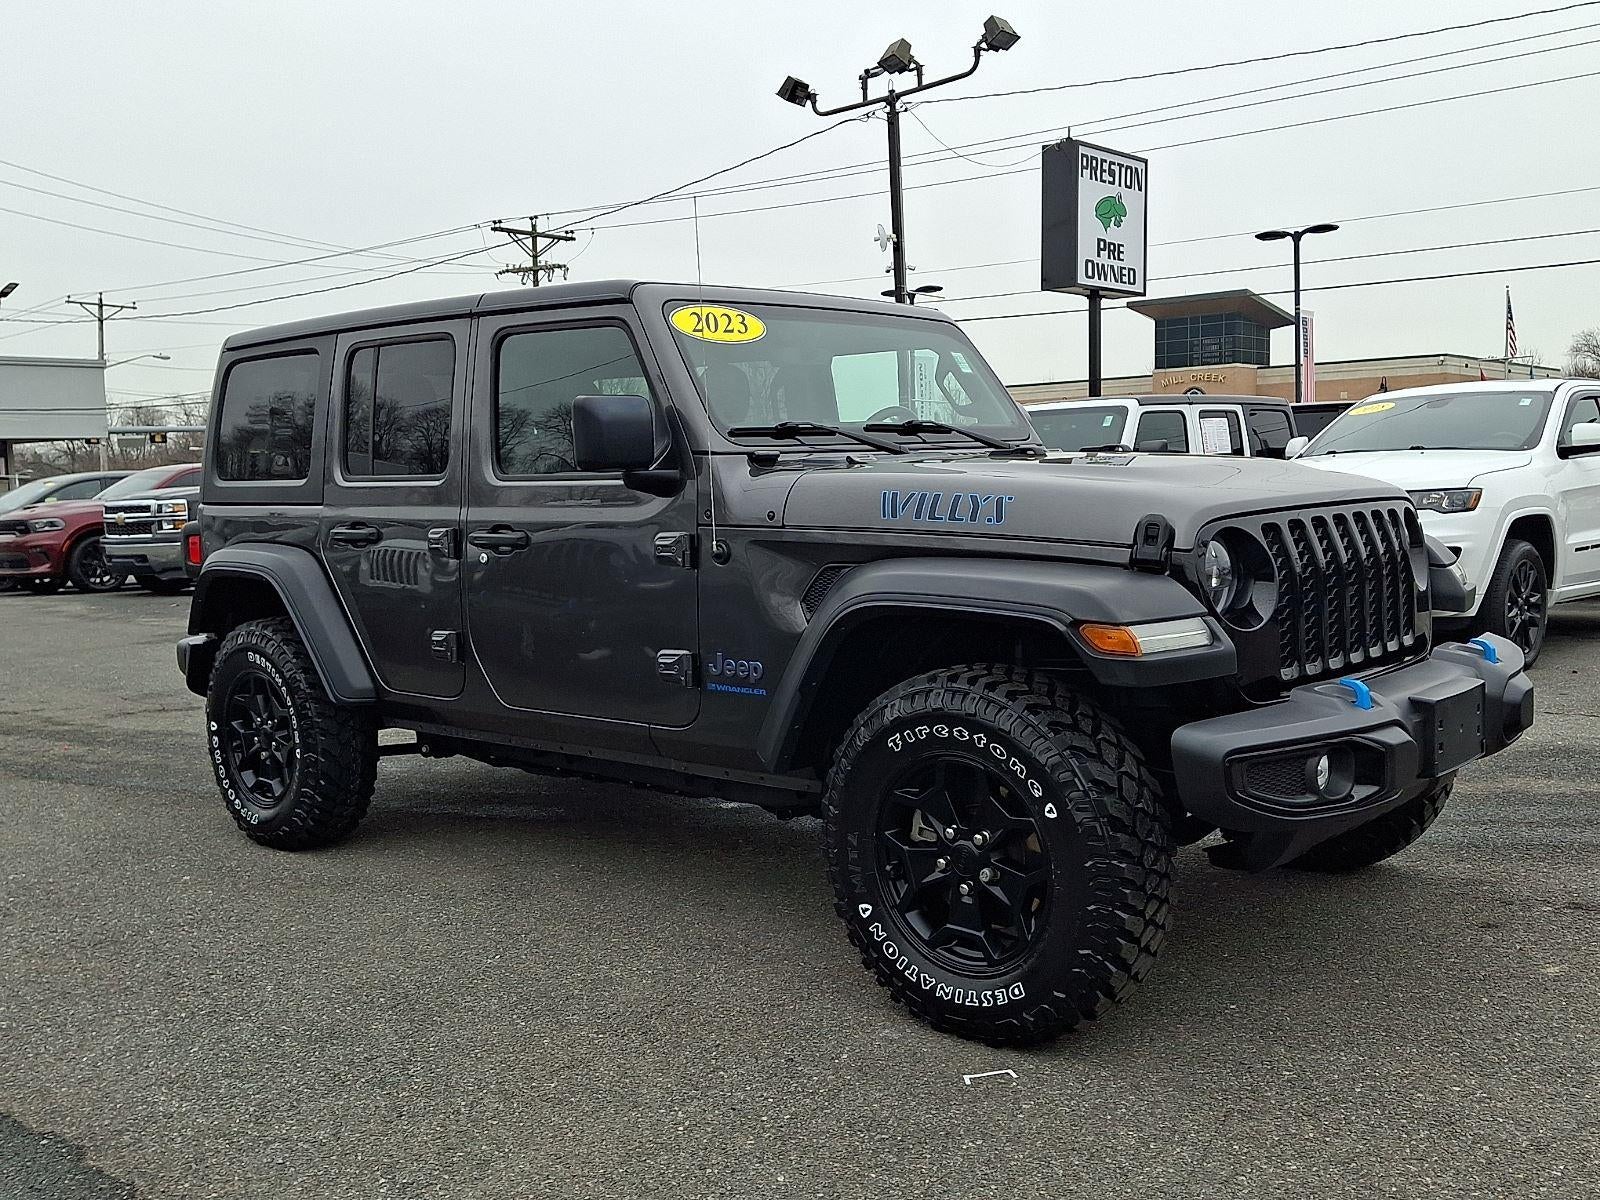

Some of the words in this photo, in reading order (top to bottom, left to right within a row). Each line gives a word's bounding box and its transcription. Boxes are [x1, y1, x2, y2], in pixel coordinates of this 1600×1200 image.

[1080, 153, 1143, 192] PRESTON
[1096, 237, 1125, 262] PRE
[1084, 258, 1137, 286] OWNED
[689, 312, 749, 334] 2023
[1160, 375, 1185, 388] MILL
[1189, 372, 1227, 383] CREEK
[880, 490, 1015, 525] WILLYS
[708, 652, 764, 684] Jeep
[715, 684, 767, 696] WRANGLER
[888, 724, 1043, 798] Firestone
[868, 922, 1026, 1007] DESTINATION
